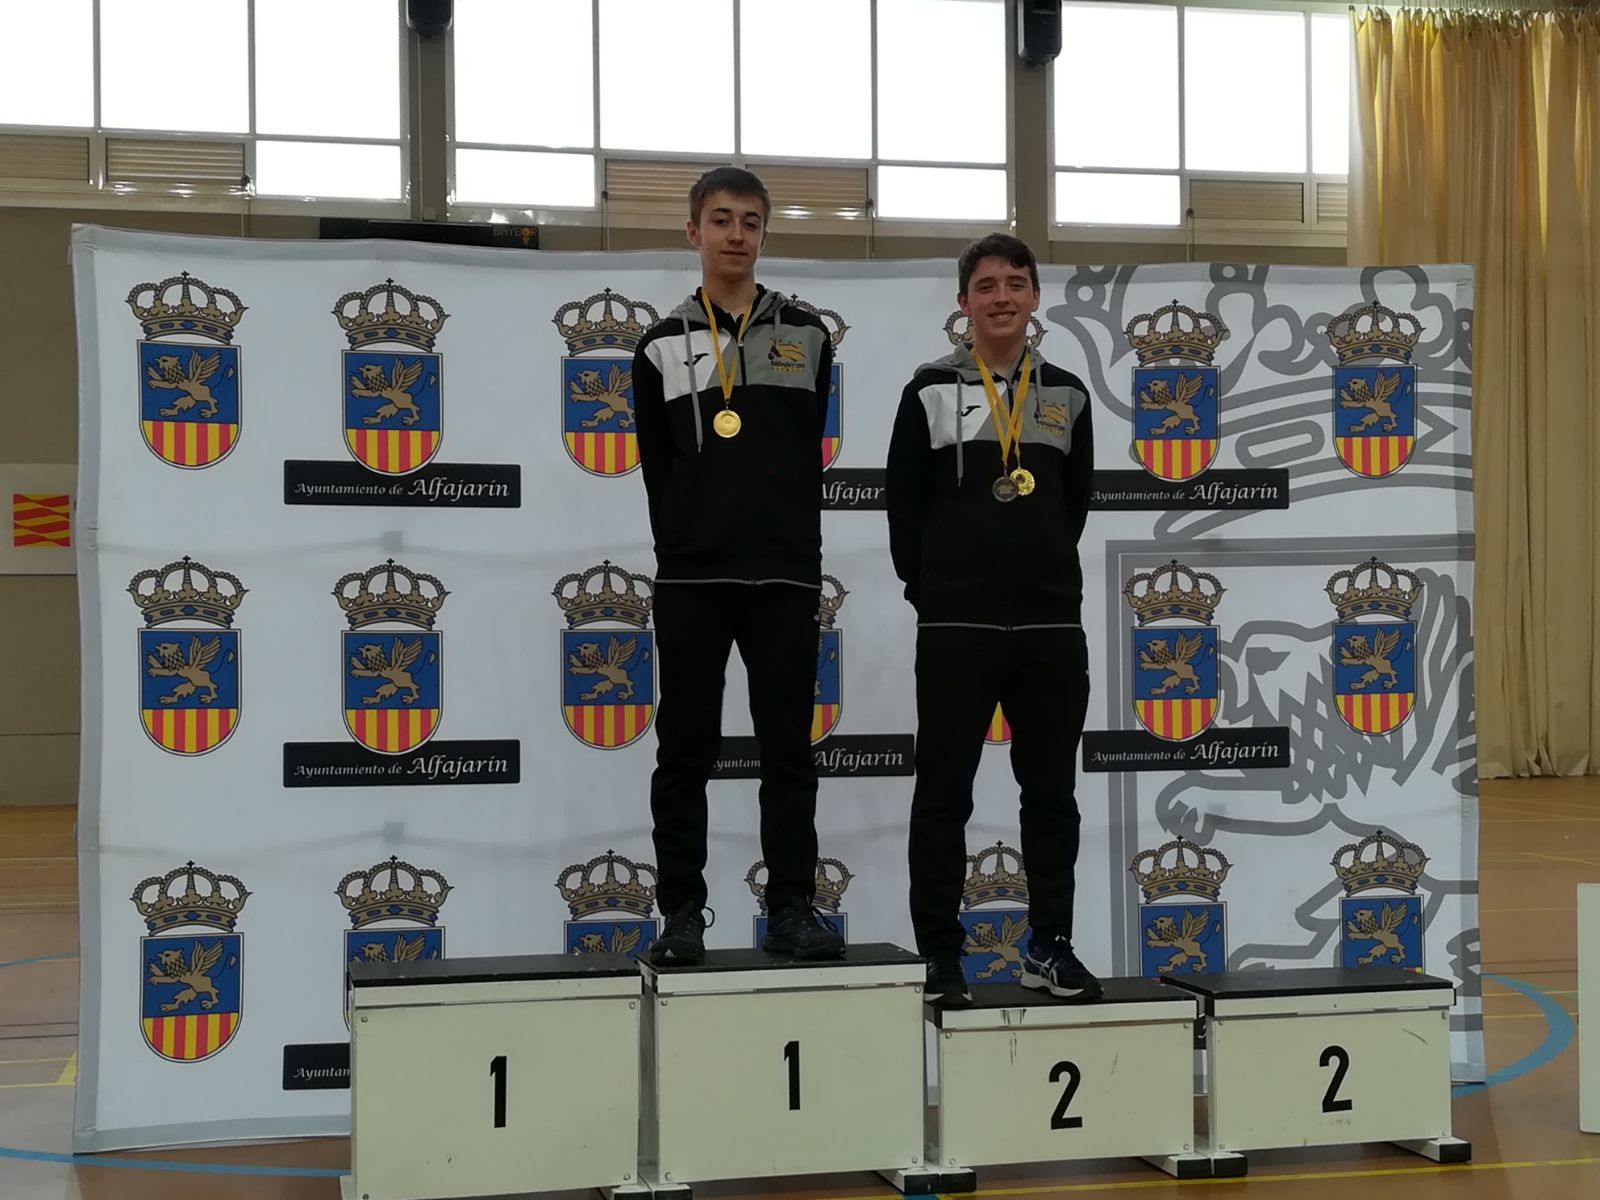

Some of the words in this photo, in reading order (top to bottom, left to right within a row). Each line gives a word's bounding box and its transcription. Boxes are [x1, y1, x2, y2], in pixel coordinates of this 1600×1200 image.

[294, 483, 386, 496] Ayuntamiento
[388, 483, 403, 495] de
[407, 476, 510, 502] Alfajarín
[822, 481, 885, 505] lfajar
[1090, 490, 1170, 503] Ayuntamiento
[1172, 489, 1185, 500] de
[1189, 481, 1279, 505] Alfajarín
[814, 748, 904, 773] Alfajarín
[1090, 751, 1171, 765] Ayuntamiento
[1173, 749, 1186, 760] de
[1190, 740, 1280, 765] Alfajarín
[294, 764, 385, 778] Ayuntamiento
[387, 762, 402, 774] de
[406, 754, 509, 780] Alfajarín
[293, 1067, 350, 1081] Ayuntam
[783, 1040, 801, 1111] 1
[1318, 1045, 1353, 1113] 2
[489, 1055, 507, 1129] 1
[1048, 1060, 1083, 1131] 2
